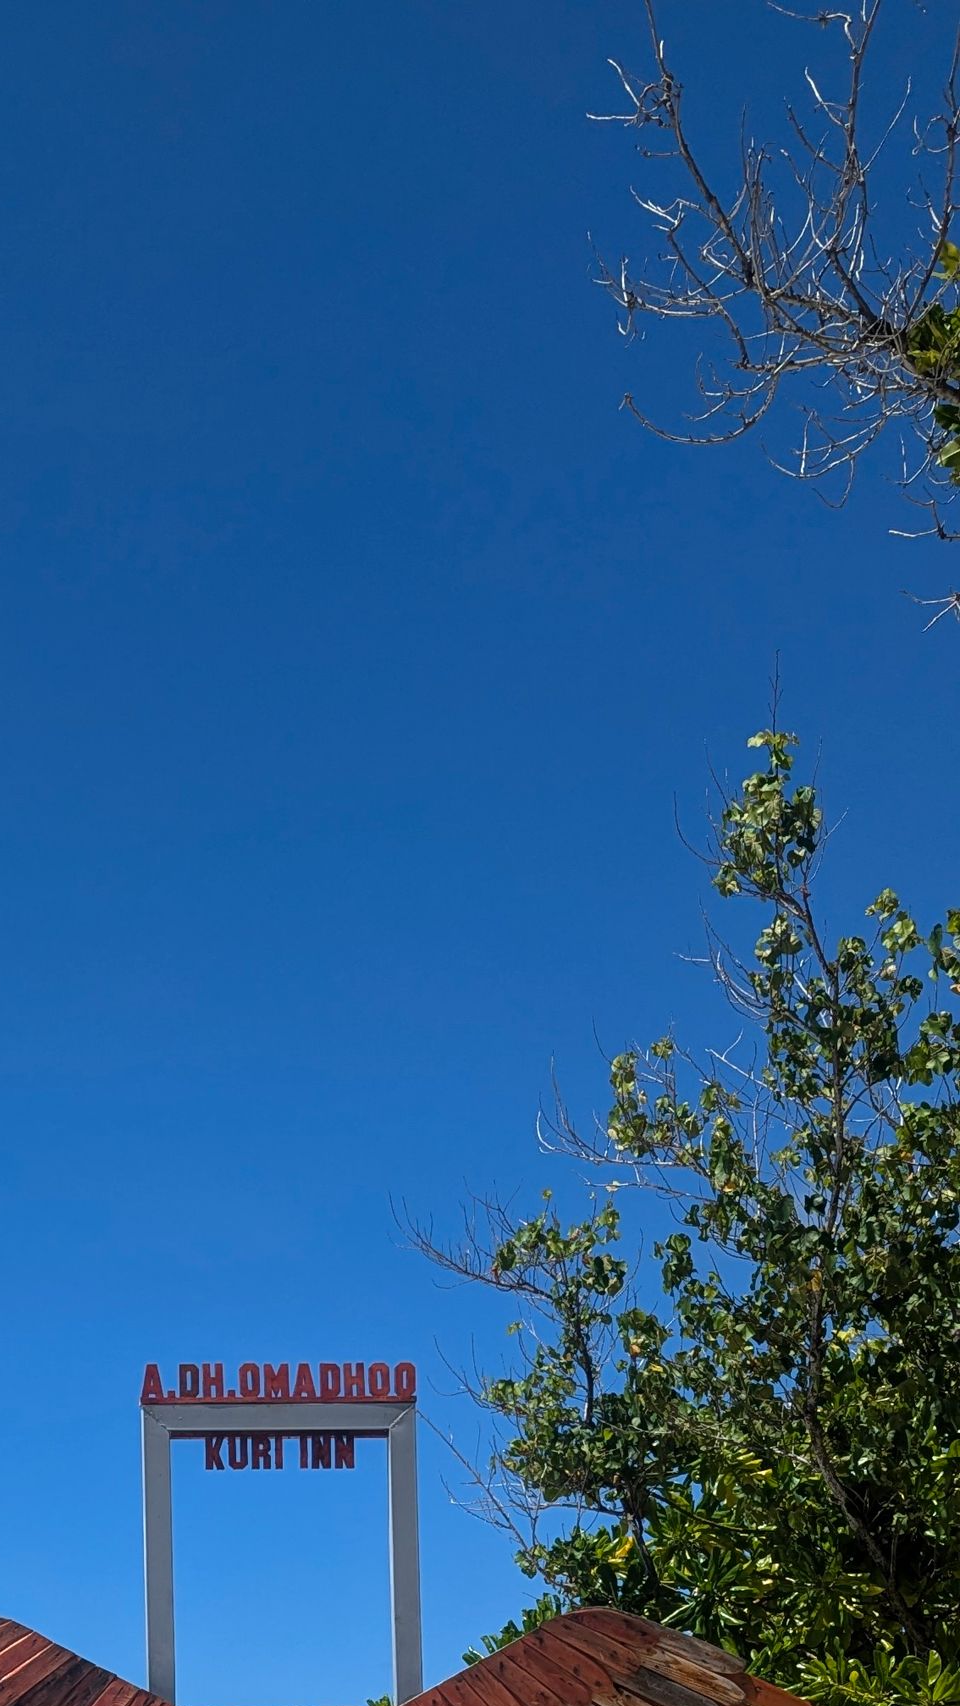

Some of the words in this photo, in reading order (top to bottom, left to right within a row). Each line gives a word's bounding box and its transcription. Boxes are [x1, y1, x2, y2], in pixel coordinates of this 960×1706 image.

[141, 1362, 417, 1400] A.DH.OMADHOO
[204, 1433, 283, 1470] KURI
[299, 1433, 355, 1470] INN
